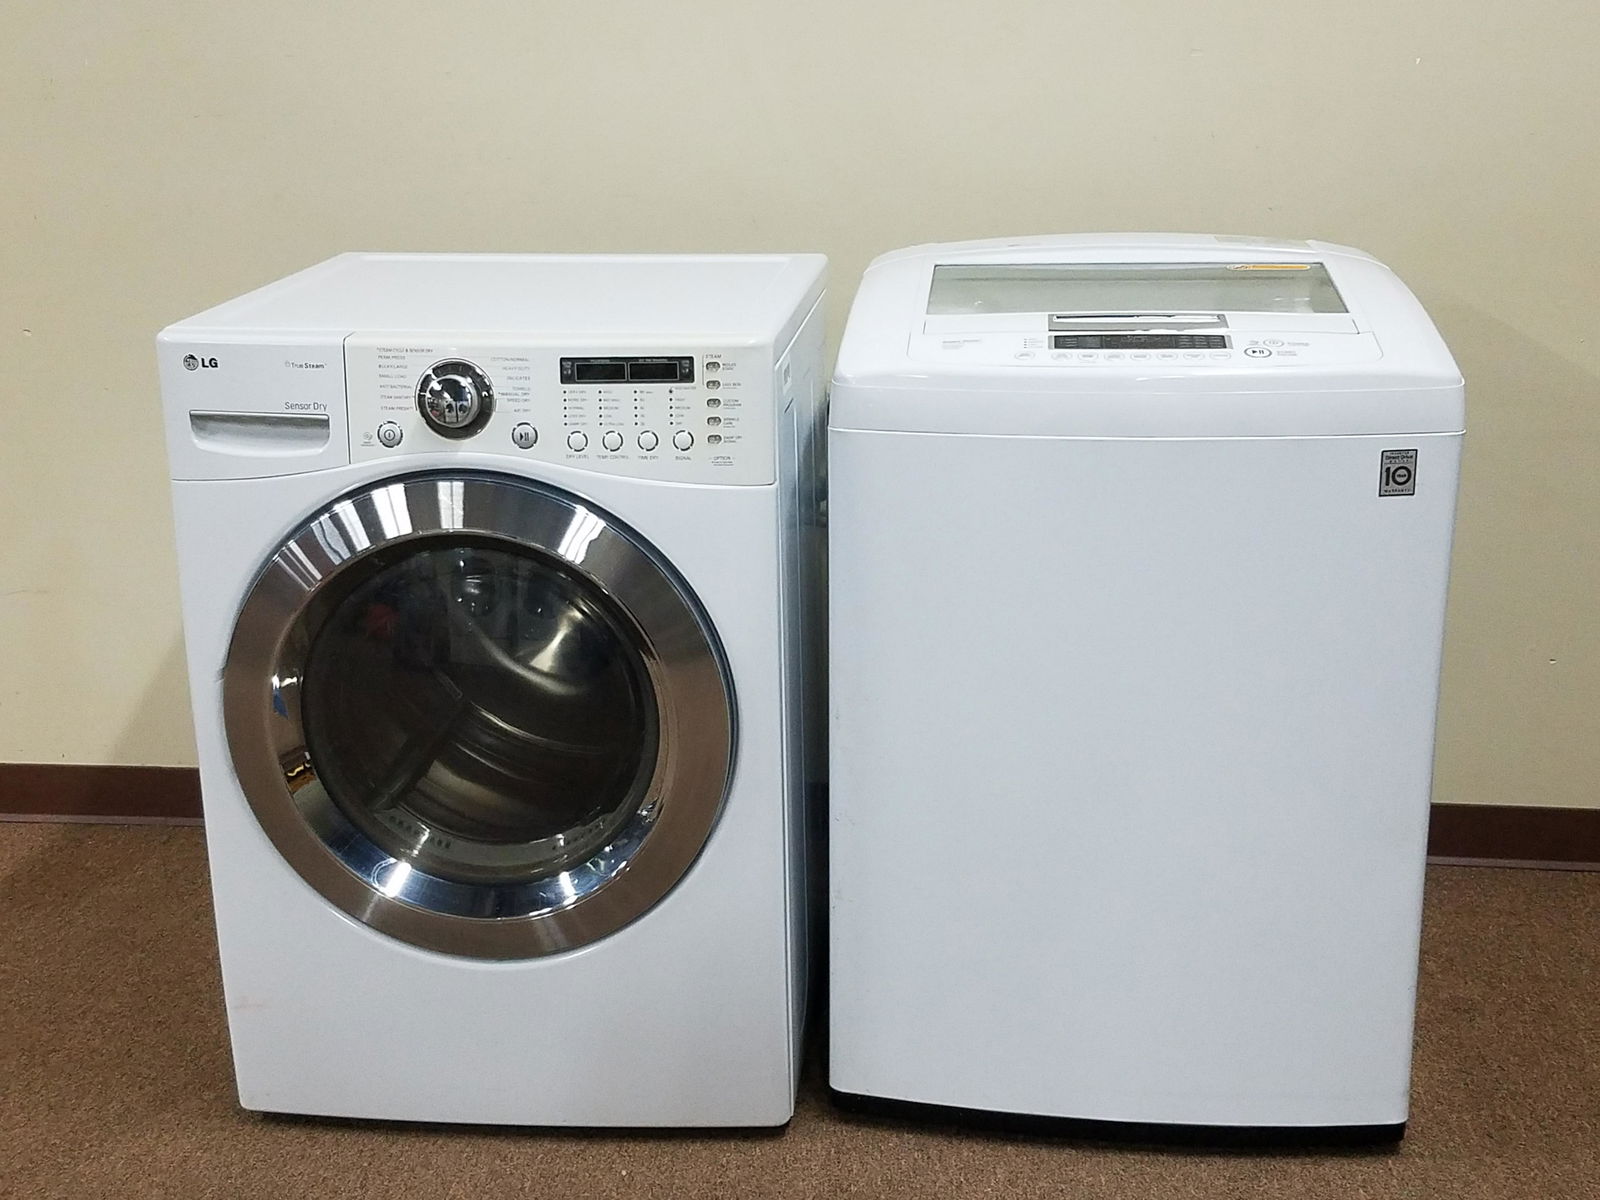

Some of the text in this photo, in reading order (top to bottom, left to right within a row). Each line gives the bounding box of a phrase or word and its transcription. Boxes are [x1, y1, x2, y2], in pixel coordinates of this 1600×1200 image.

[201, 357, 218, 368] LG
[284, 401, 328, 411] Sensor Dry
[1385, 466, 1412, 486] 10
